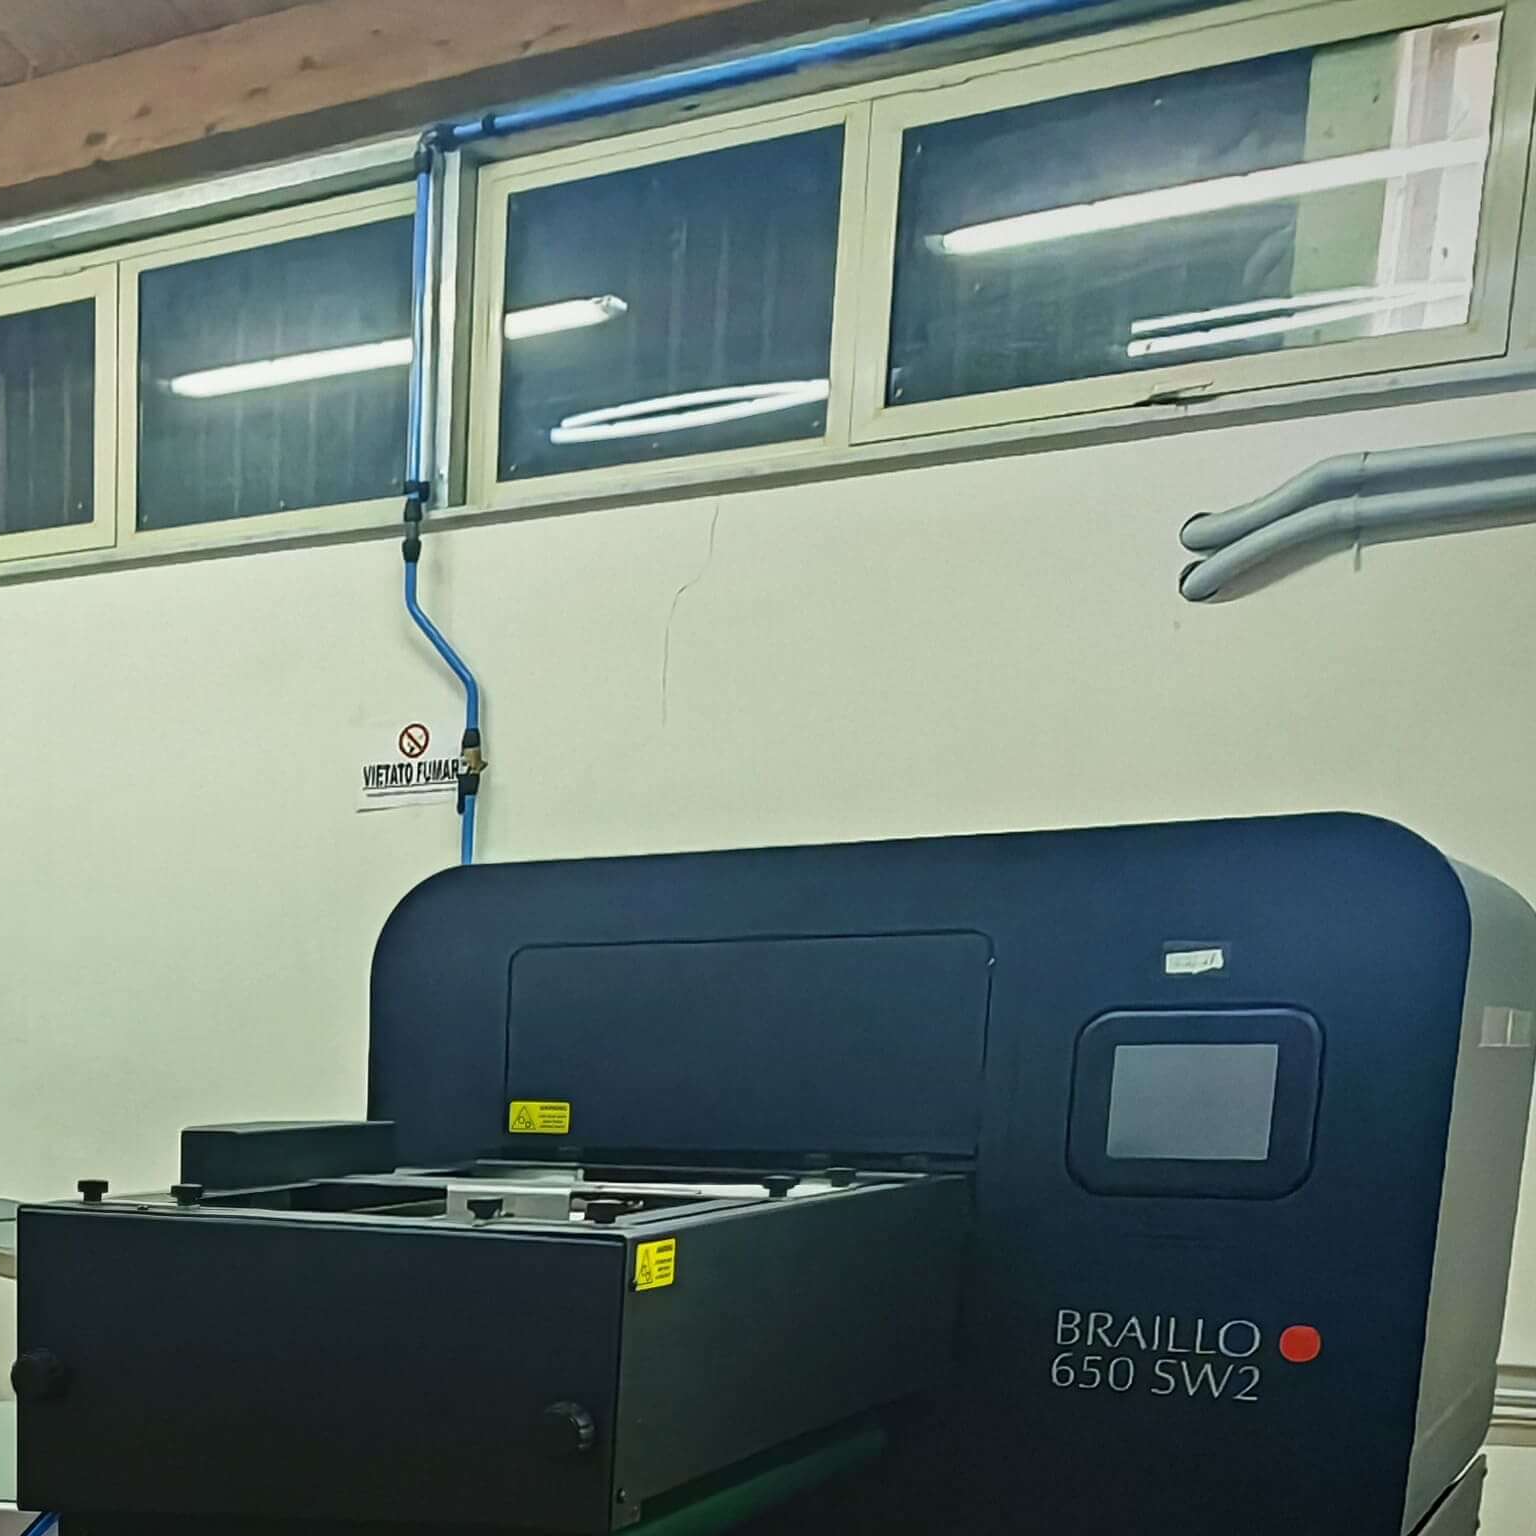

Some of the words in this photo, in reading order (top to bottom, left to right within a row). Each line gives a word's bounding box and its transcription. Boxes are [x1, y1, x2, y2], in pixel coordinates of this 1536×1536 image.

[363, 763, 413, 787] VIETATO
[1056, 1309, 1261, 1357] BRAILLO
[1051, 1352, 1135, 1392] 650
[1150, 1359, 1261, 1401] SW2
